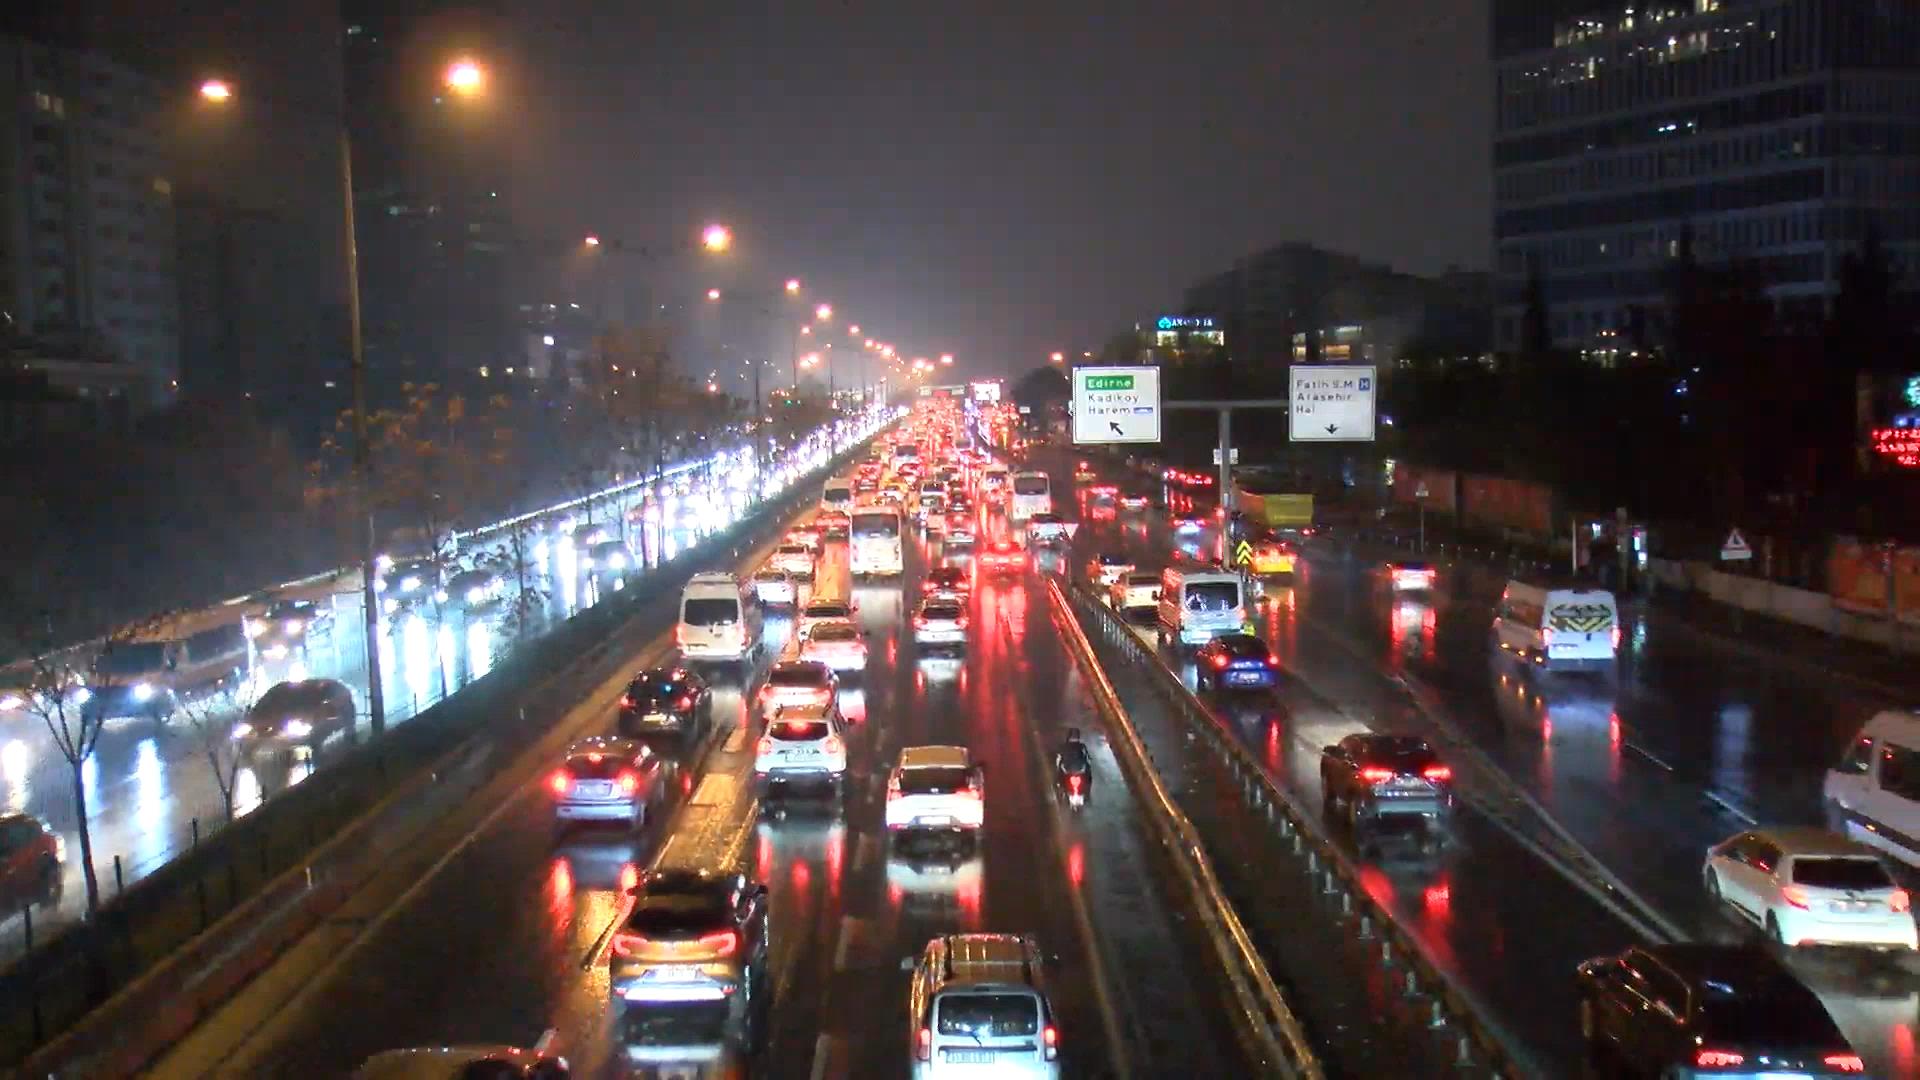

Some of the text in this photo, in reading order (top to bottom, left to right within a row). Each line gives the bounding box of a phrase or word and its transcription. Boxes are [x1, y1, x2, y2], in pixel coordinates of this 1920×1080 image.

[1088, 379, 1132, 389] Edirne
[1297, 380, 1329, 389] Fatih
[1089, 406, 1131, 415] Harem
